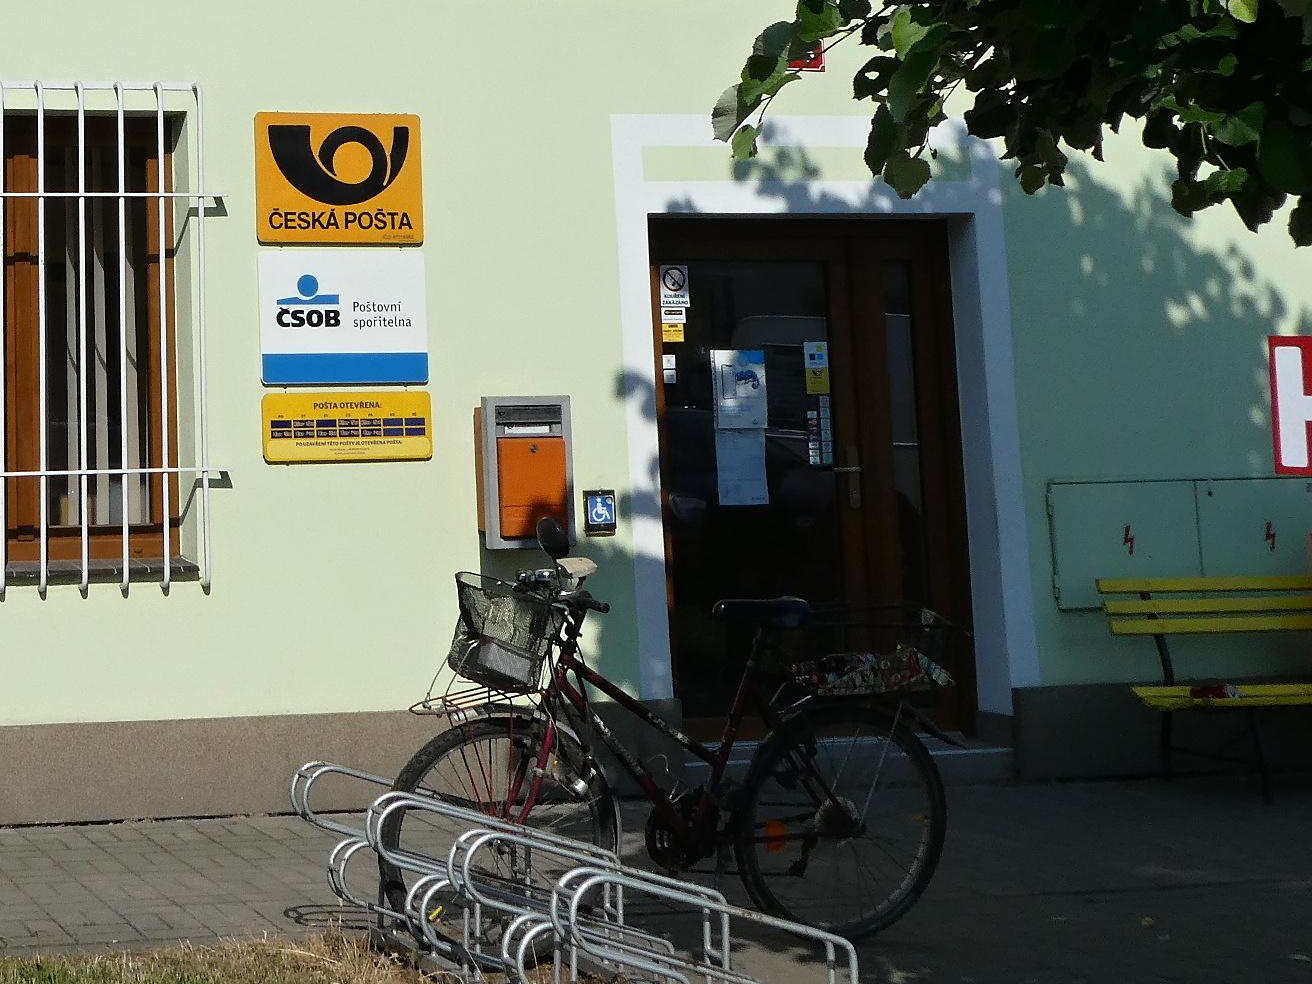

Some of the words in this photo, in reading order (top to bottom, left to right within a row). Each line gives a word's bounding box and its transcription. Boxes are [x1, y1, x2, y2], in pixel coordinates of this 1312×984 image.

[269, 208, 340, 230] ČESKÁ
[344, 208, 413, 230] POŠTA
[352, 301, 402, 313] Poštovní
[276, 306, 341, 328] ČSOB
[352, 316, 412, 330] spořitelna
[313, 401, 338, 409] POŠTA
